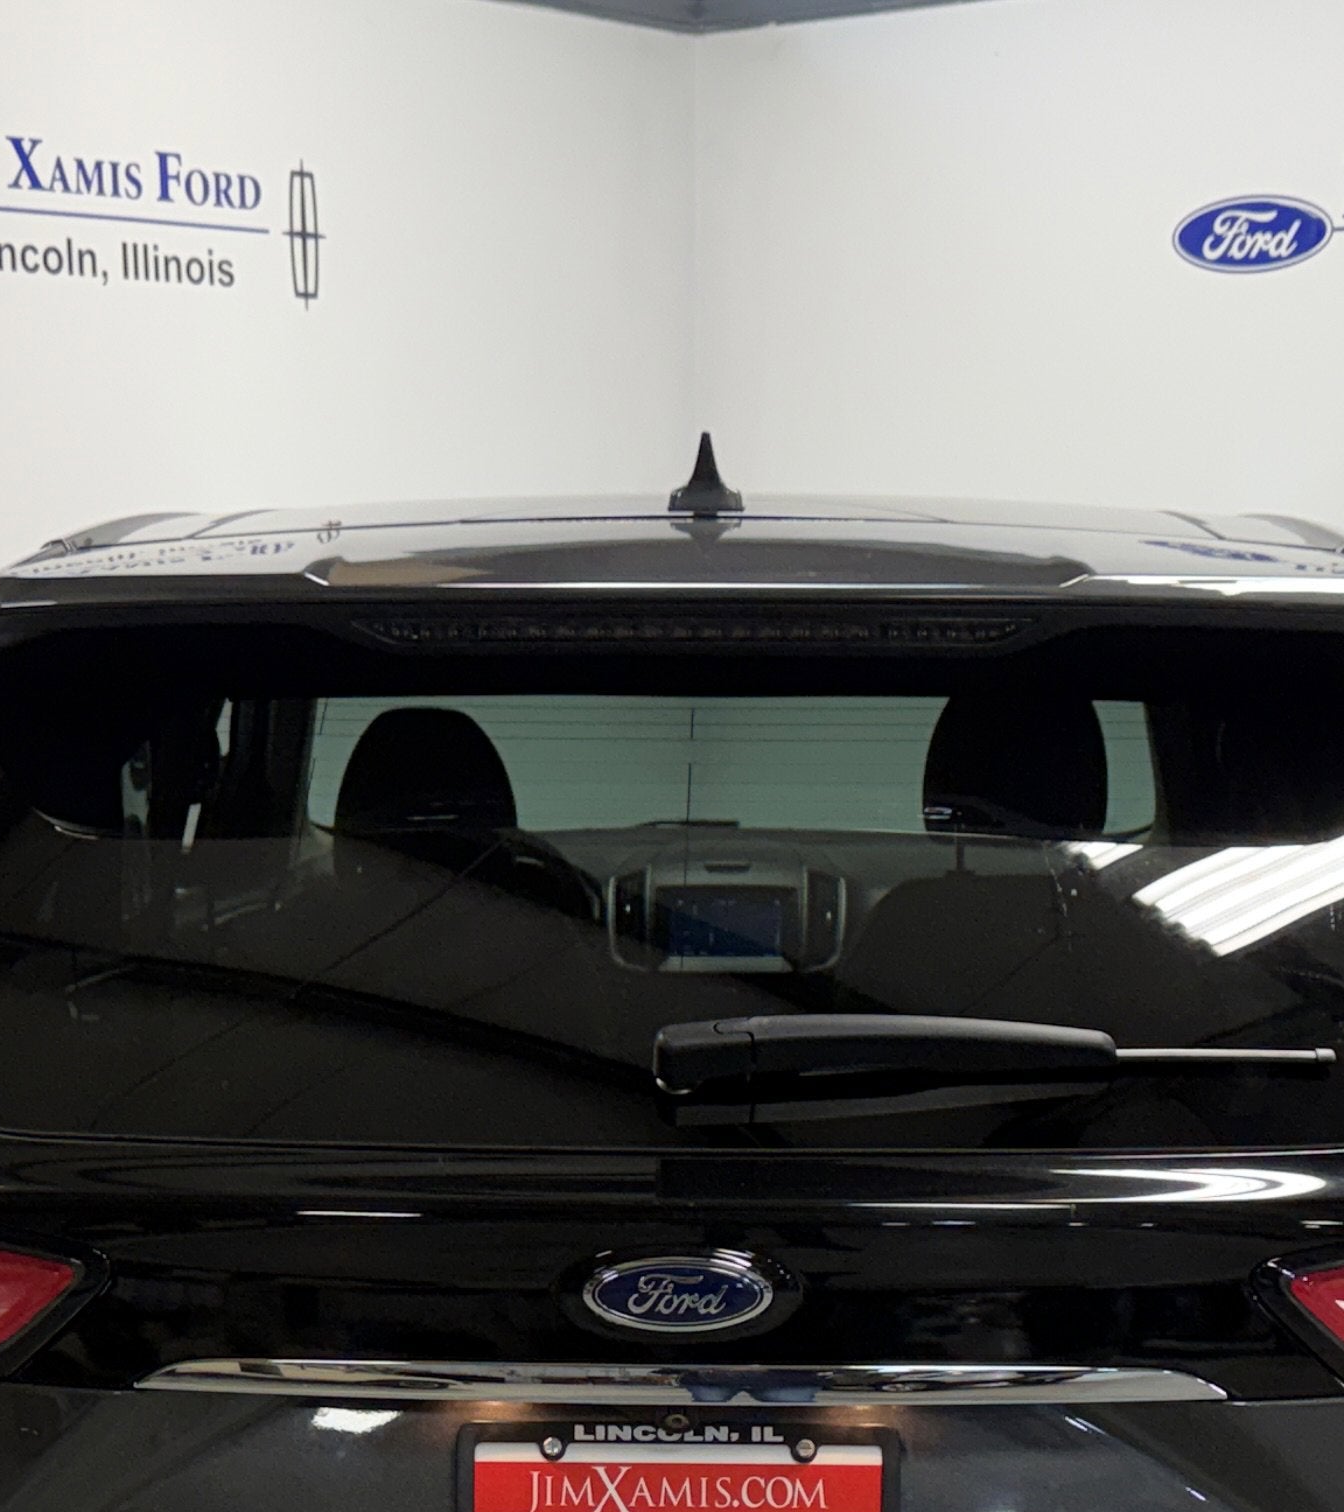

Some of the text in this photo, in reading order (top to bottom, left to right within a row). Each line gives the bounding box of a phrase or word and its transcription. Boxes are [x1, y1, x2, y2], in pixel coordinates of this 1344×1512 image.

[6, 135, 143, 200] XAMIS
[155, 151, 261, 210] FORD
[1202, 208, 1299, 260] Ford
[122, 243, 236, 288] Illinois
[627, 1273, 728, 1315] Ford
[751, 1426, 784, 1442] IL
